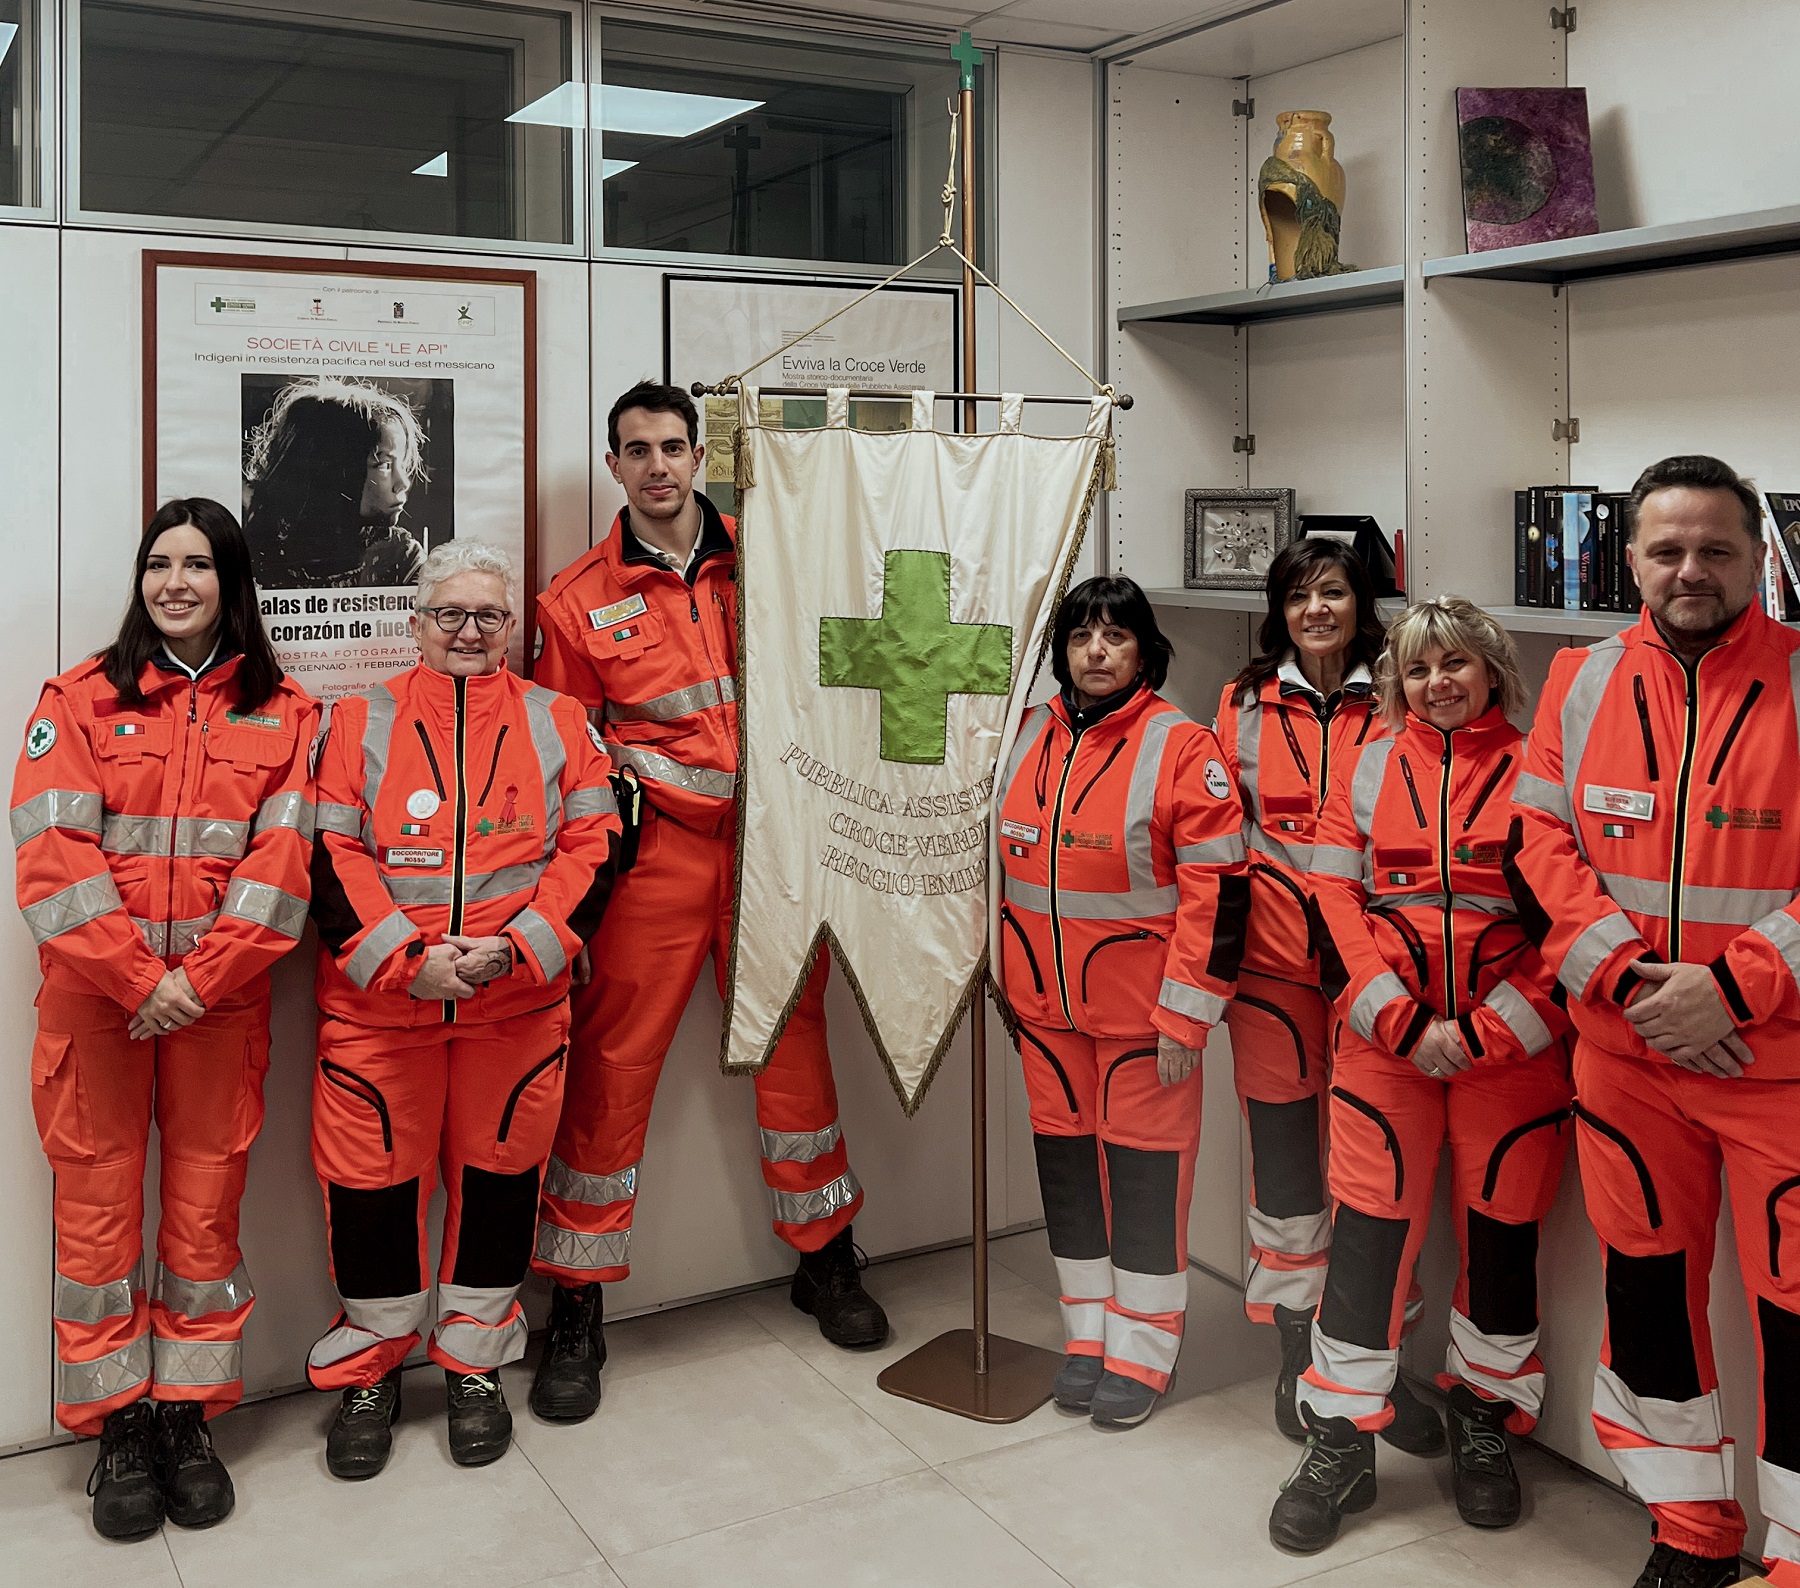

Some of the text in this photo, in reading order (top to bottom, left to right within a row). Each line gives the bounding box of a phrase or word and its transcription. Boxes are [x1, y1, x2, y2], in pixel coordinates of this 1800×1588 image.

[246, 336, 448, 356] SOCIETÀ CIVILE "LE API"
[194, 352, 496, 370] Indigeni in resistenza pacifica nel sud-est messicano
[782, 355, 926, 374] Evviva la Croce Verde
[782, 372, 874, 382] Mostra storico-documentaria
[1580, 550, 1590, 584] Wings
[260, 594, 416, 616] alas de resistenc
[270, 620, 414, 642] corazón de fueg
[334, 646, 420, 657] FOTOGRAFIC
[298, 662, 347, 672] GENNAIO
[364, 660, 416, 669] FEBBRAIO
[322, 682, 367, 692] Fotografie
[780, 742, 994, 818] PUBBLICA ASSISTE
[828, 811, 908, 856] CROCE
[391, 850, 440, 859] SOCCORRITORE
[820, 844, 916, 896] REGGIO
